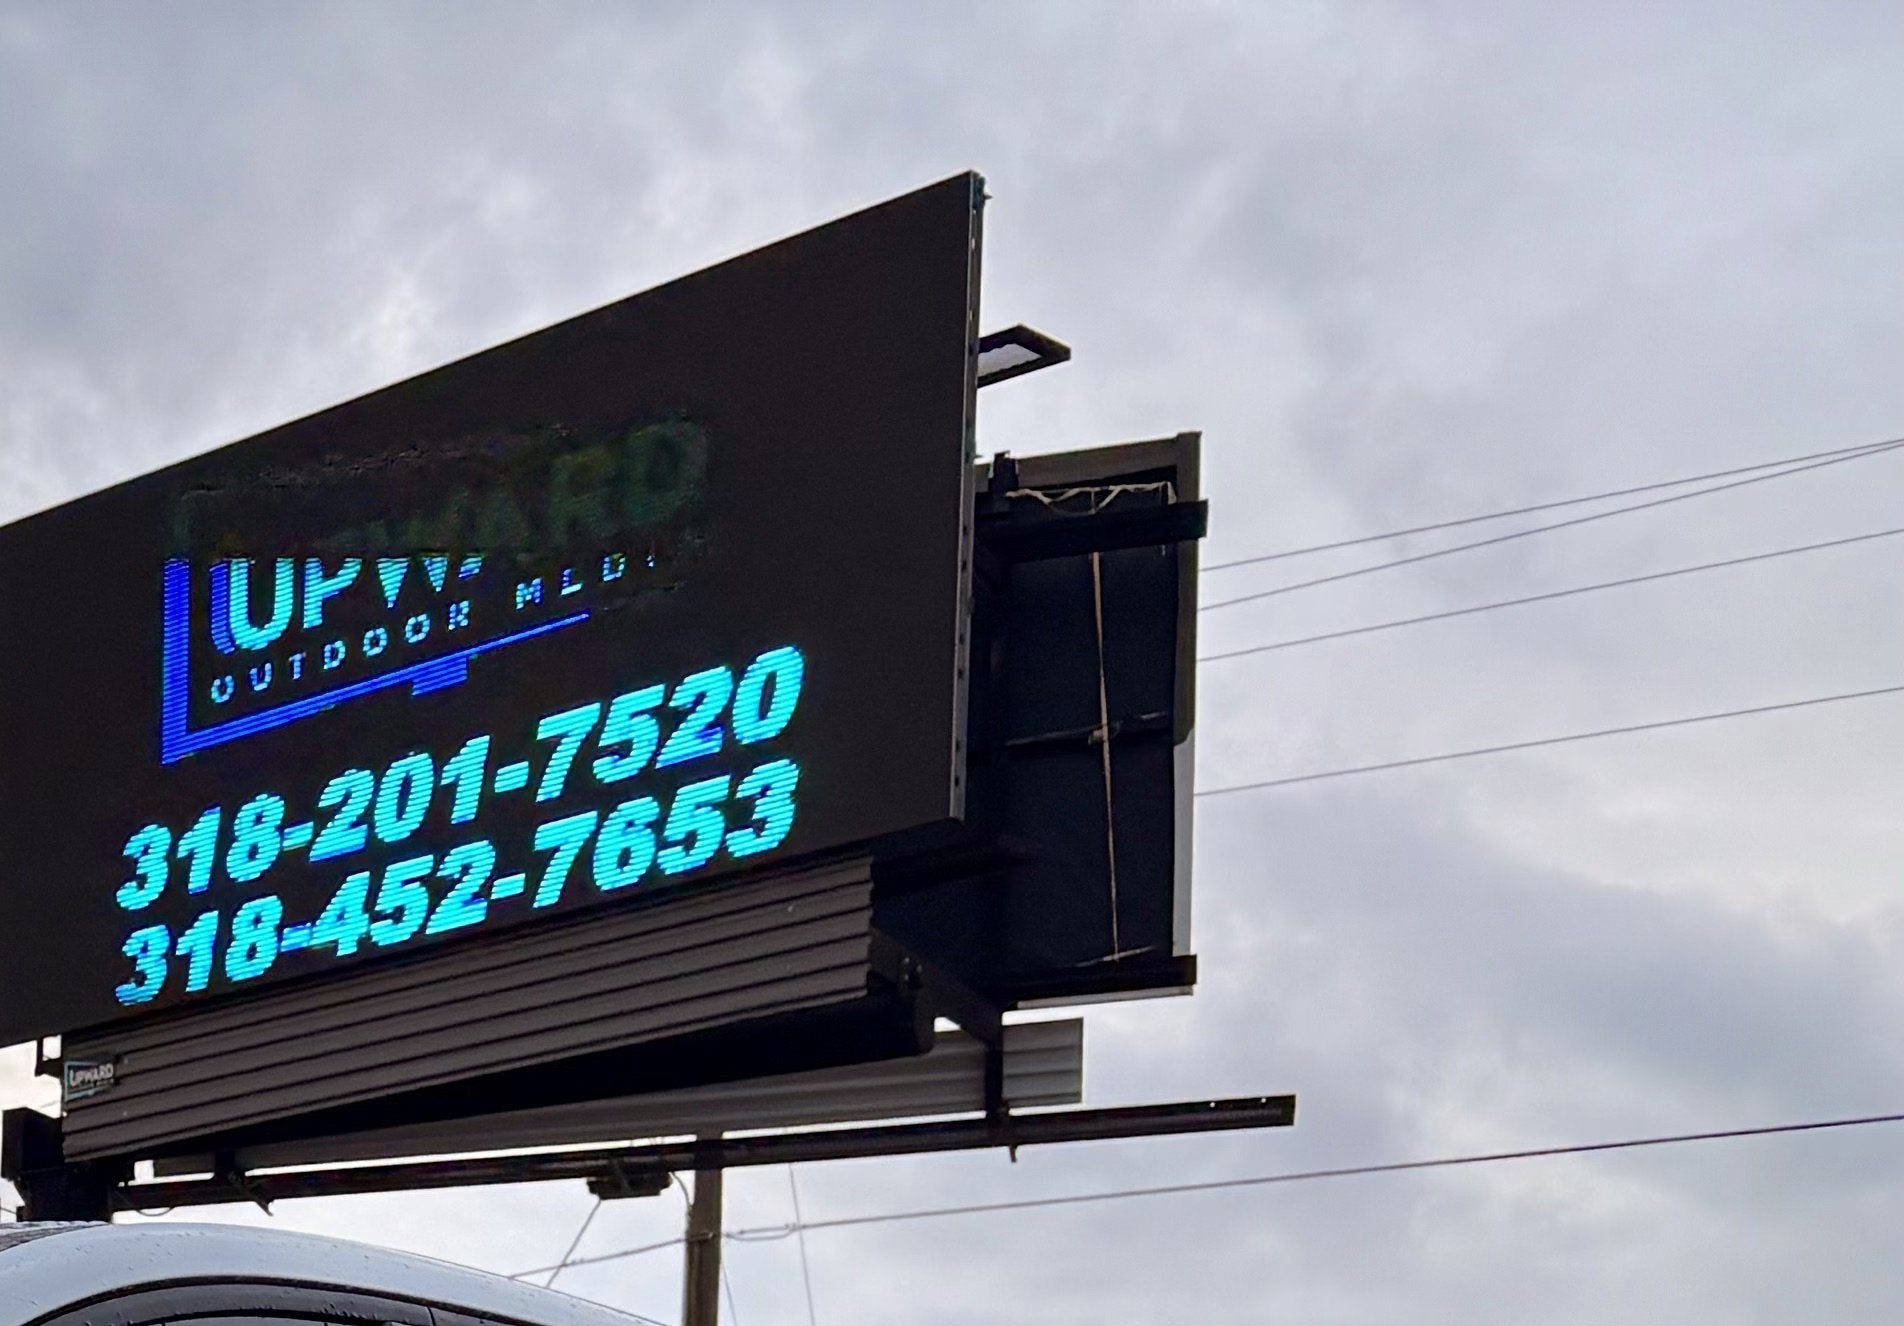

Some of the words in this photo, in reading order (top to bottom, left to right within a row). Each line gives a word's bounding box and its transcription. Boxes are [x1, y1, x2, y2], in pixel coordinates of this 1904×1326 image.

[210, 600, 471, 704] OUTDOOR
[114, 758, 800, 1006] 318-452-7653
[115, 645, 805, 911] 318-201-7520
